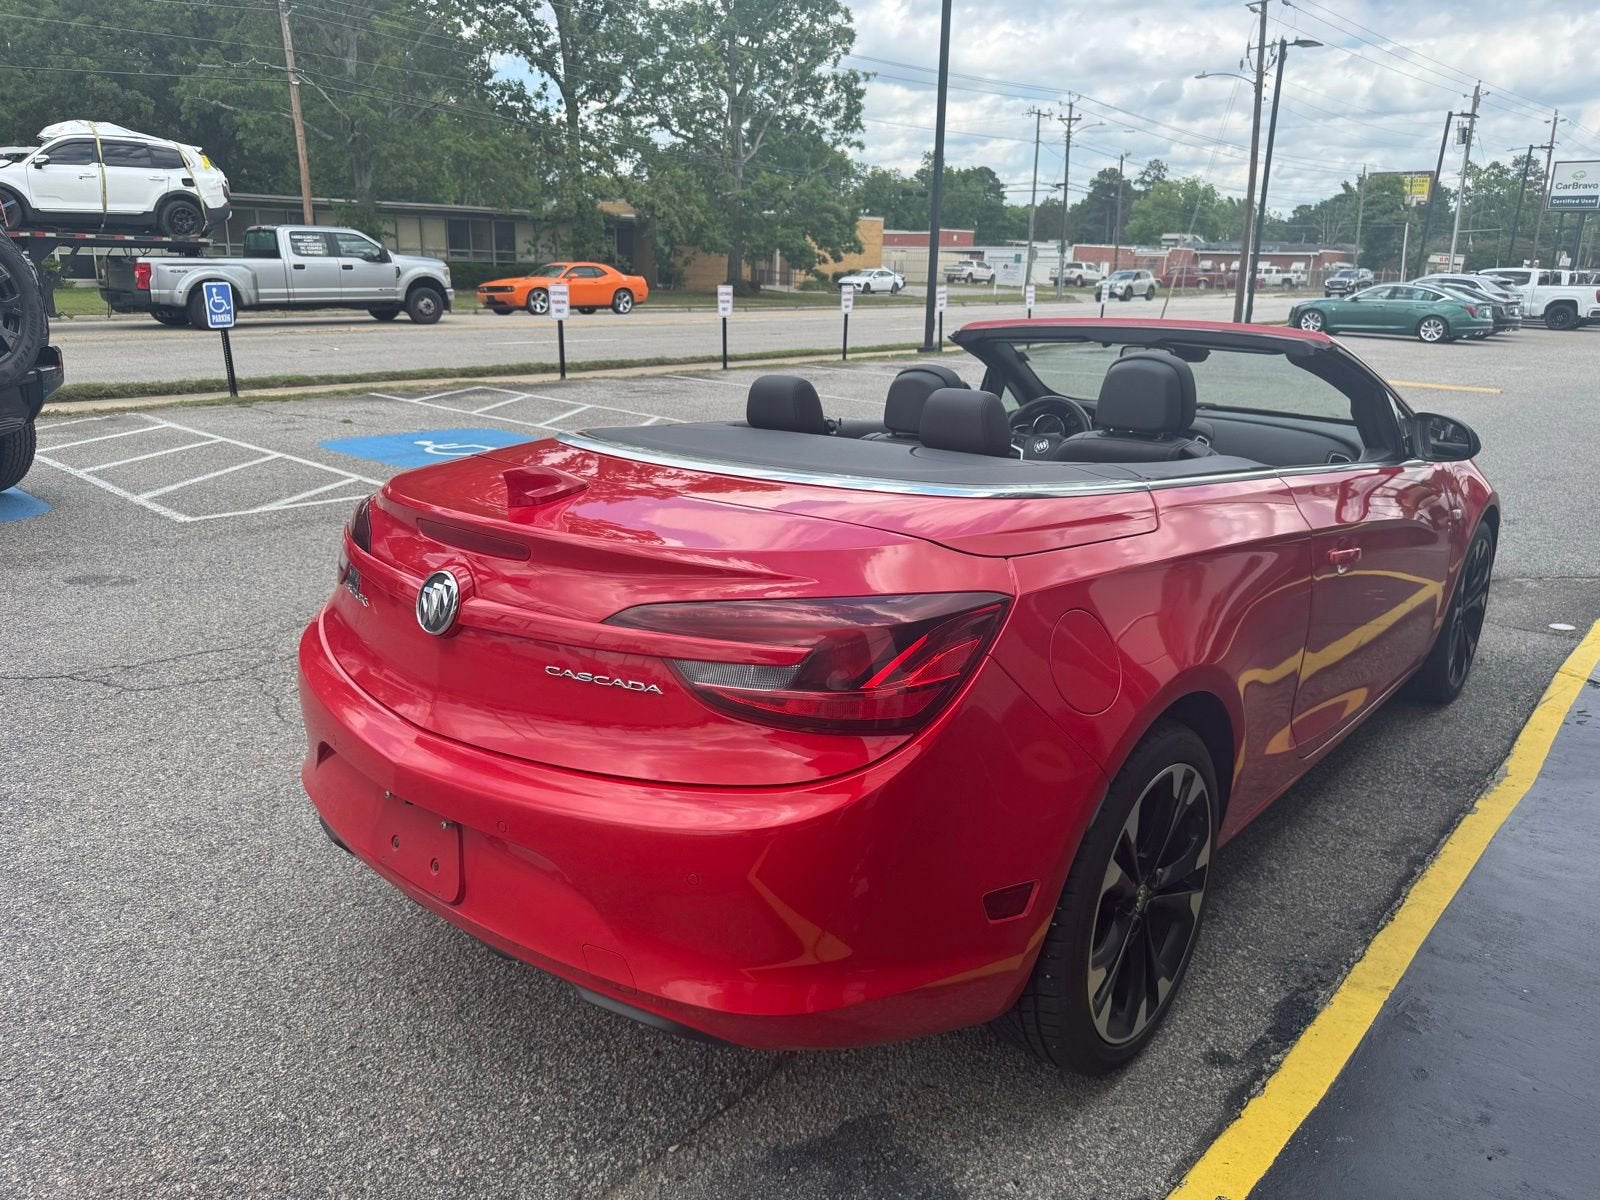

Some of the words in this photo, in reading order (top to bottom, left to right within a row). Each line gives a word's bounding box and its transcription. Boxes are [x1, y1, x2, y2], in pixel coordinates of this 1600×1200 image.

[1555, 182, 1599, 190] CarBravo
[211, 314, 231, 323] PARKING
[545, 665, 664, 695] CASCADA
